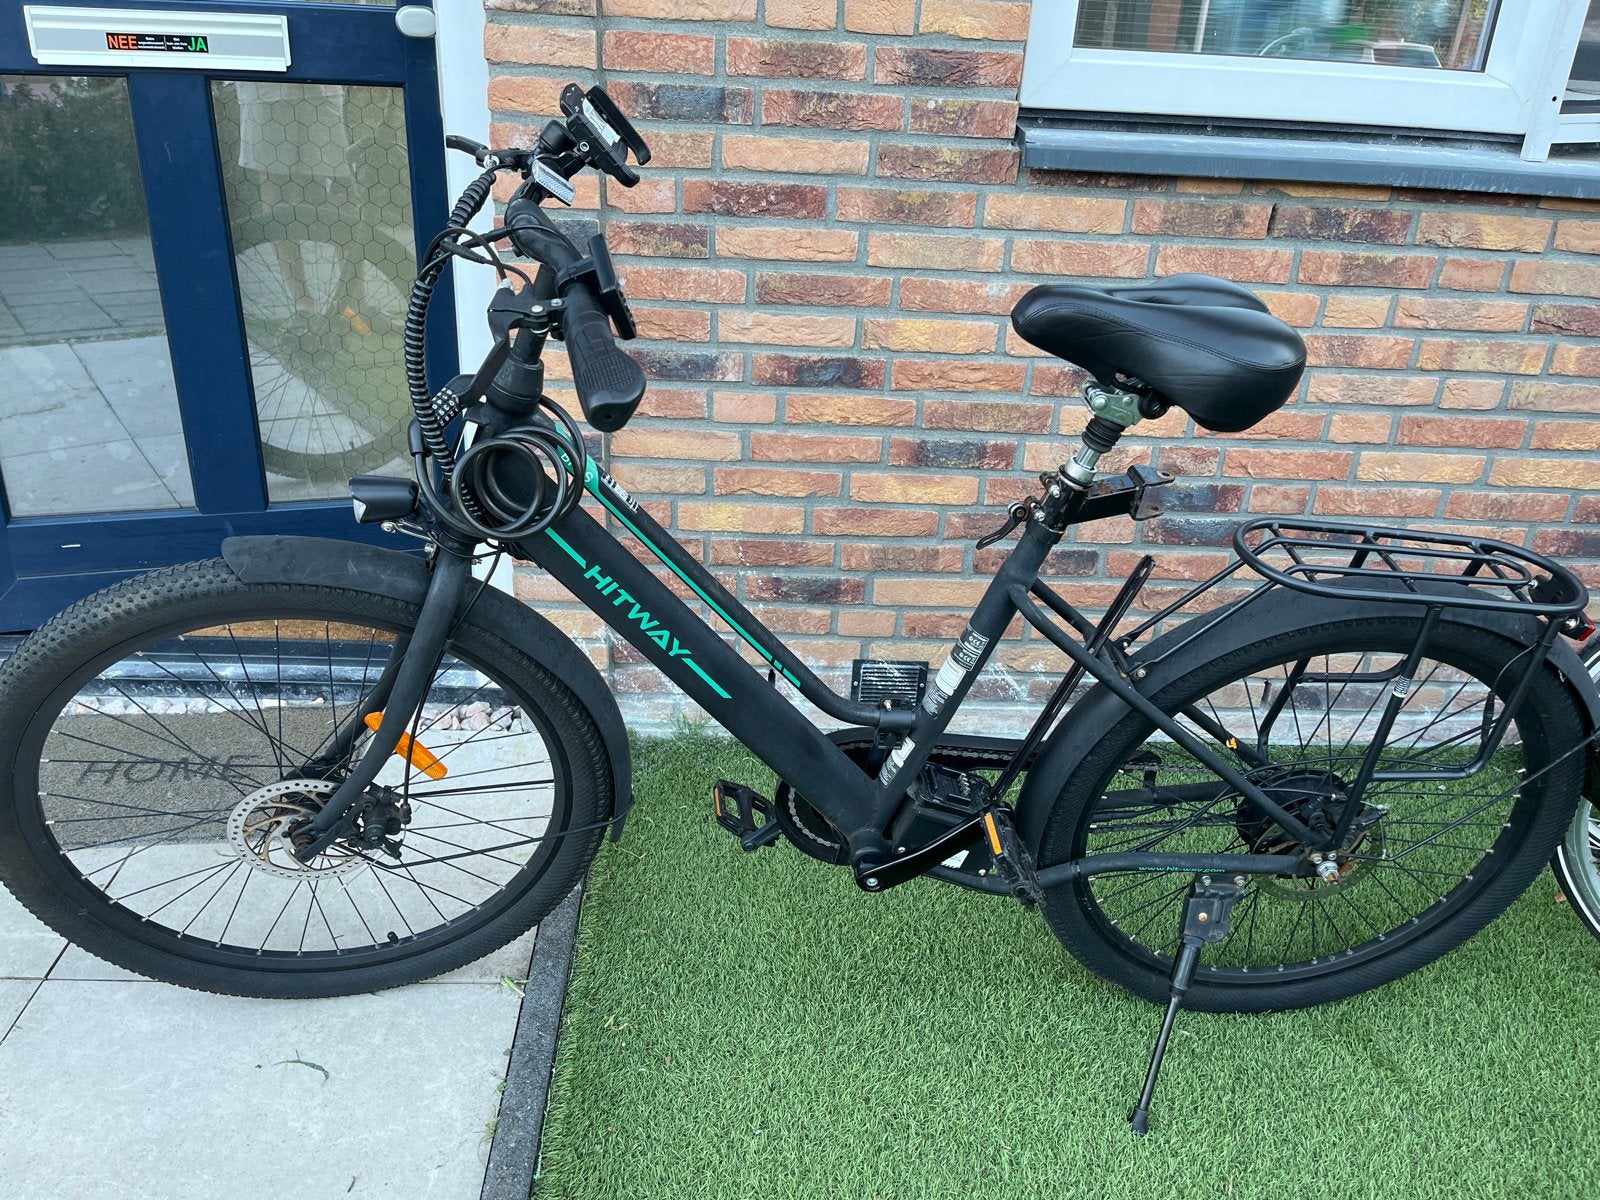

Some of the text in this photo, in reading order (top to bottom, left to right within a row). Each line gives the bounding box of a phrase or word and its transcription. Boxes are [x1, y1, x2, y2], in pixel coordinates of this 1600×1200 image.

[108, 35, 138, 49] NEE
[188, 36, 207, 51] JA
[583, 565, 693, 657] HITWAY
